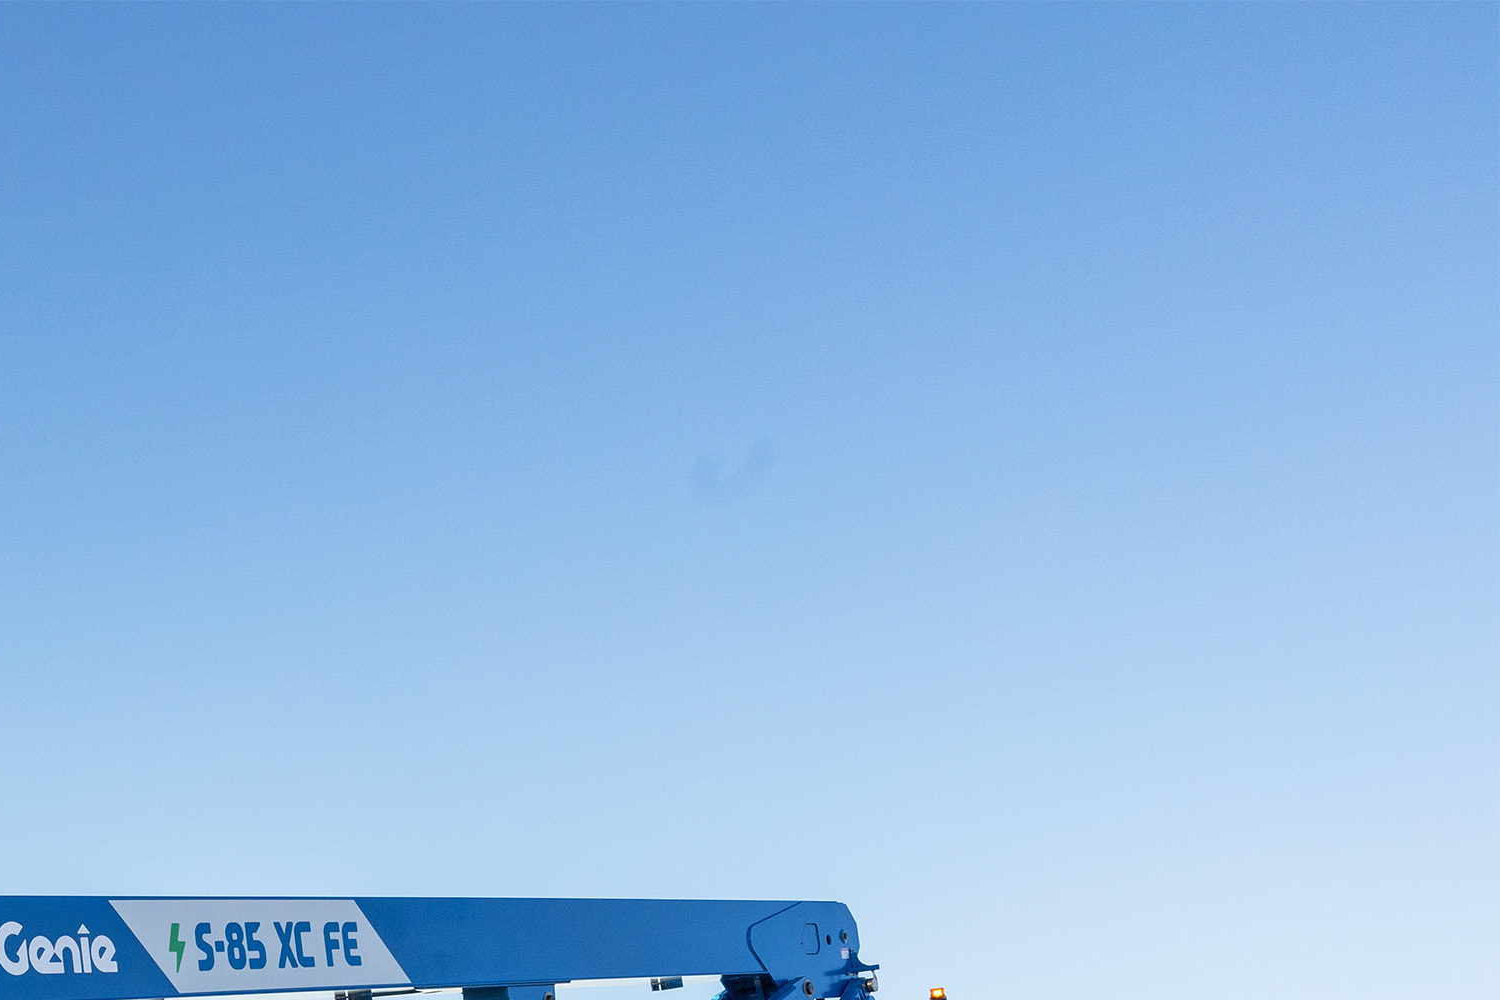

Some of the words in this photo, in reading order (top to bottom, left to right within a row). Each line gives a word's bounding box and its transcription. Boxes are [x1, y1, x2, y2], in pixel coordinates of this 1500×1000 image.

[194, 921, 267, 972] S-85
[272, 920, 316, 969] XC
[323, 920, 363, 967] FE
